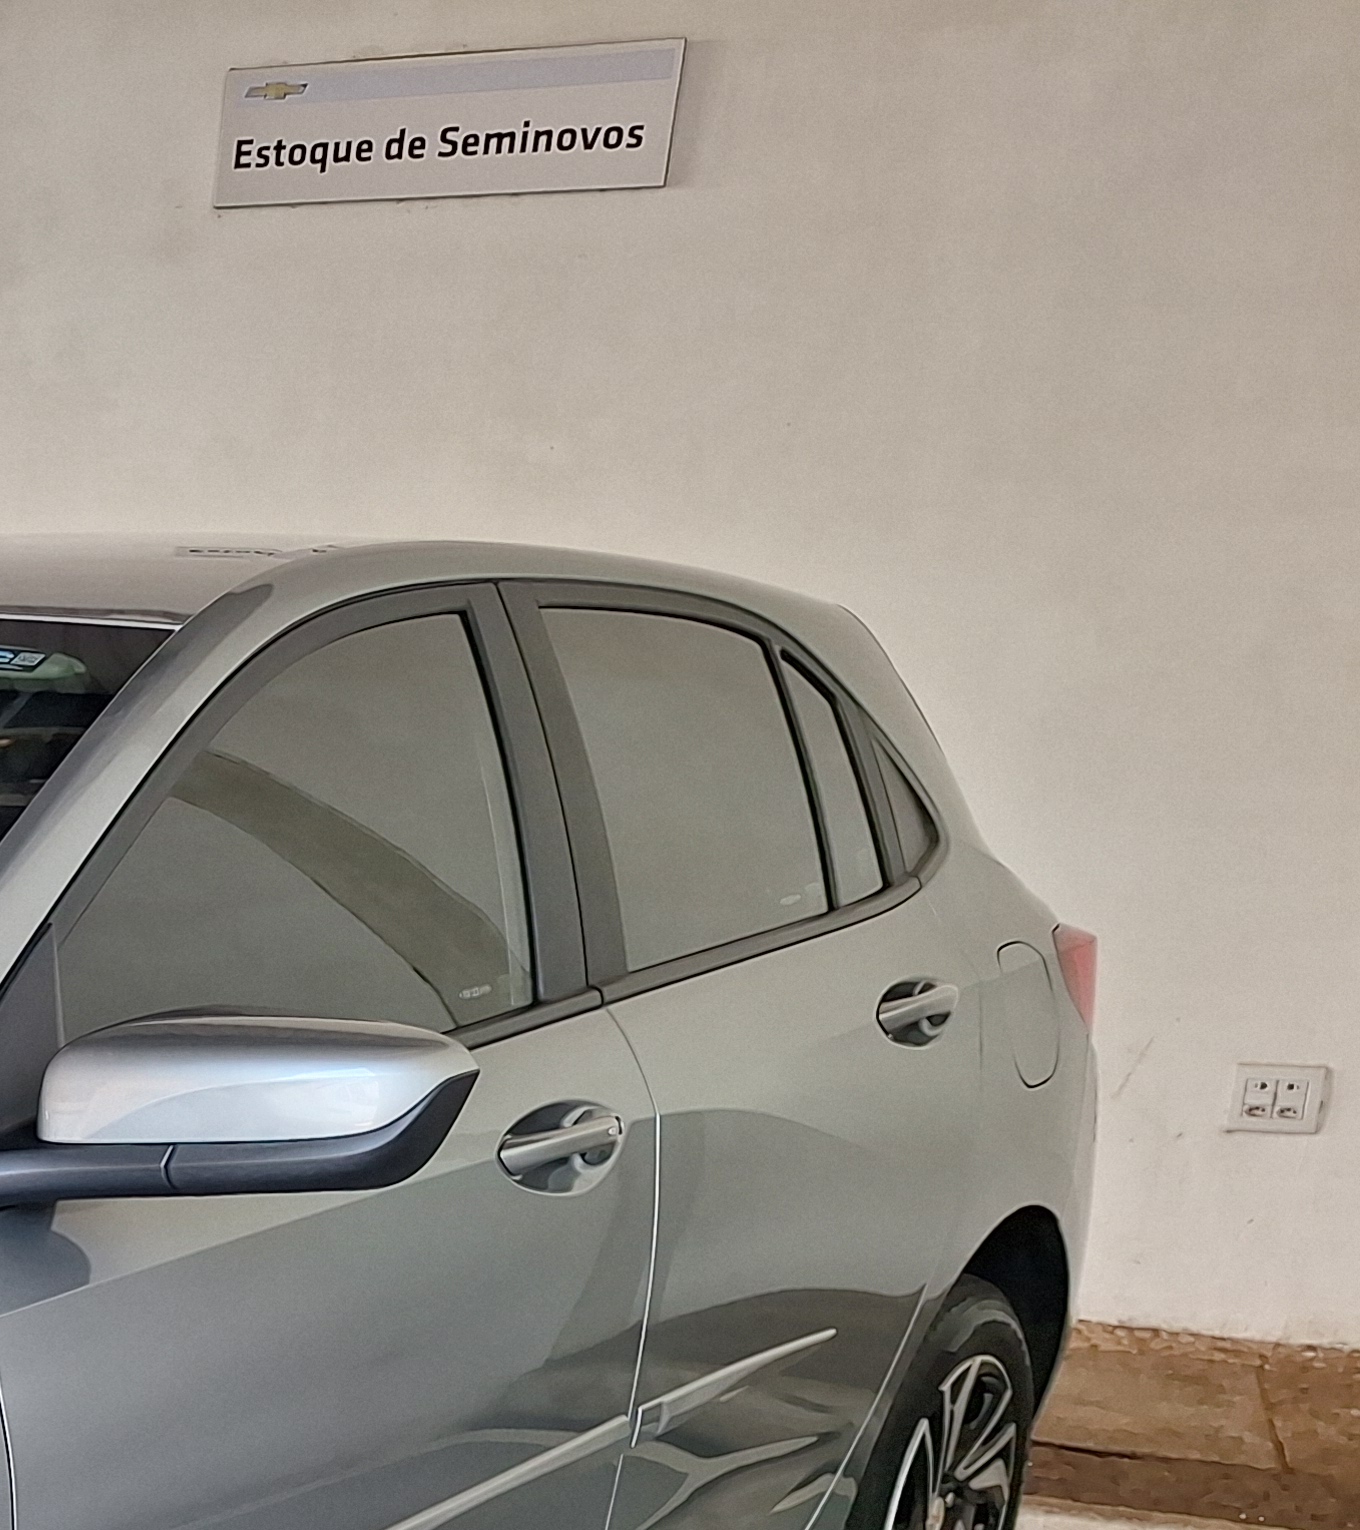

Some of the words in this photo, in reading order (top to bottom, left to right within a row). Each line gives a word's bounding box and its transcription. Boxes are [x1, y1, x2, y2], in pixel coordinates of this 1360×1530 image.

[233, 137, 373, 173] Estoque
[384, 127, 426, 160] de
[437, 119, 645, 158] Seminovos
